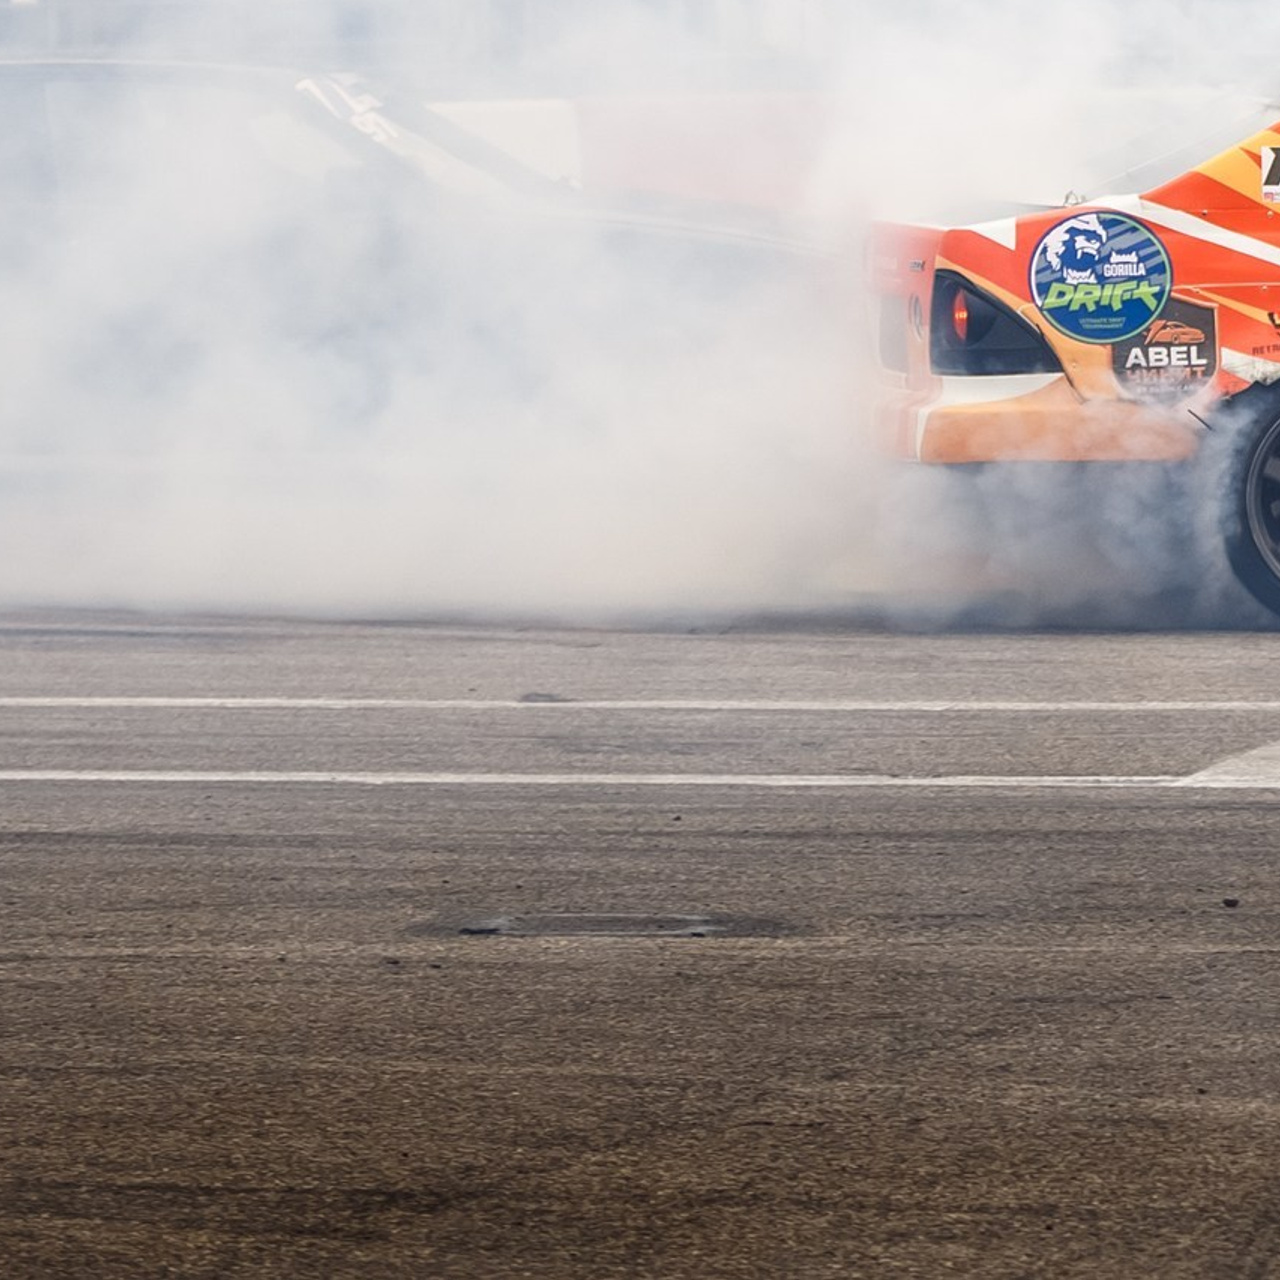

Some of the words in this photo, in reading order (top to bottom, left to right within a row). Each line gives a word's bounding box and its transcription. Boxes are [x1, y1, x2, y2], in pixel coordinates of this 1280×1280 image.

[1103, 263, 1147, 278] GORILLA
[1042, 280, 1161, 312] DRIFT
[1125, 346, 1208, 368] ABEL
